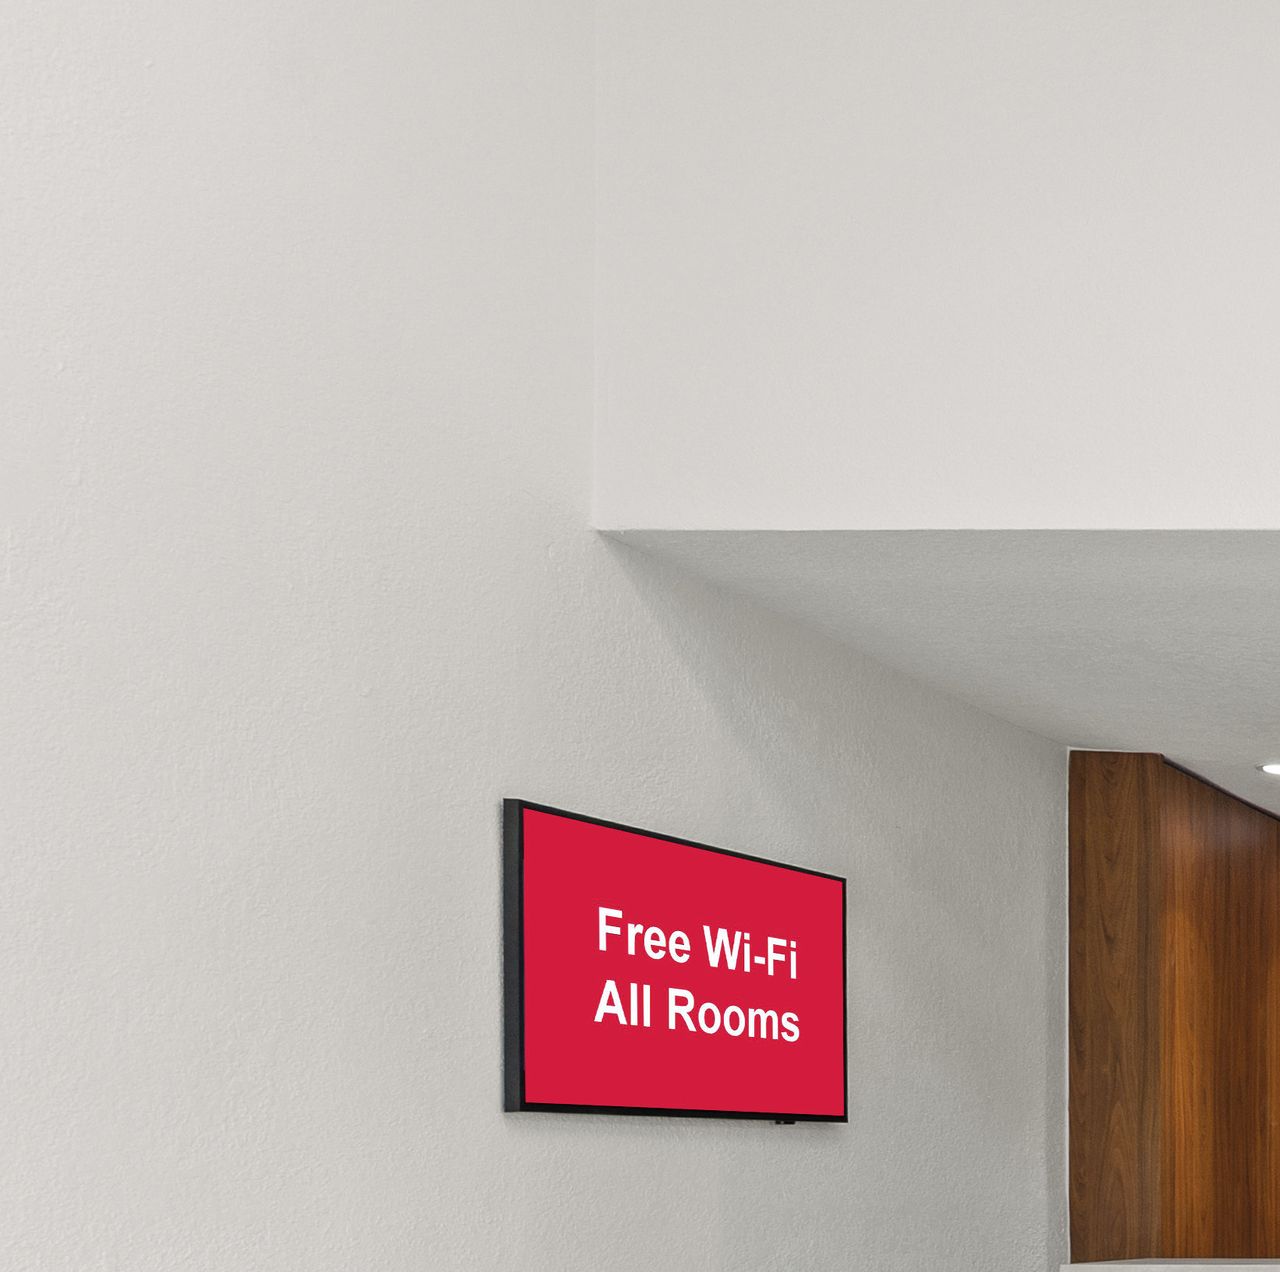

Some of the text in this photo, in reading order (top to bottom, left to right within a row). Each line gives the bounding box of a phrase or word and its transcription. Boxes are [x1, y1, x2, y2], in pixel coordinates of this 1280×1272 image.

[598, 906, 797, 980] Free Wi-Fi
[594, 979, 800, 1043] All Rooms
